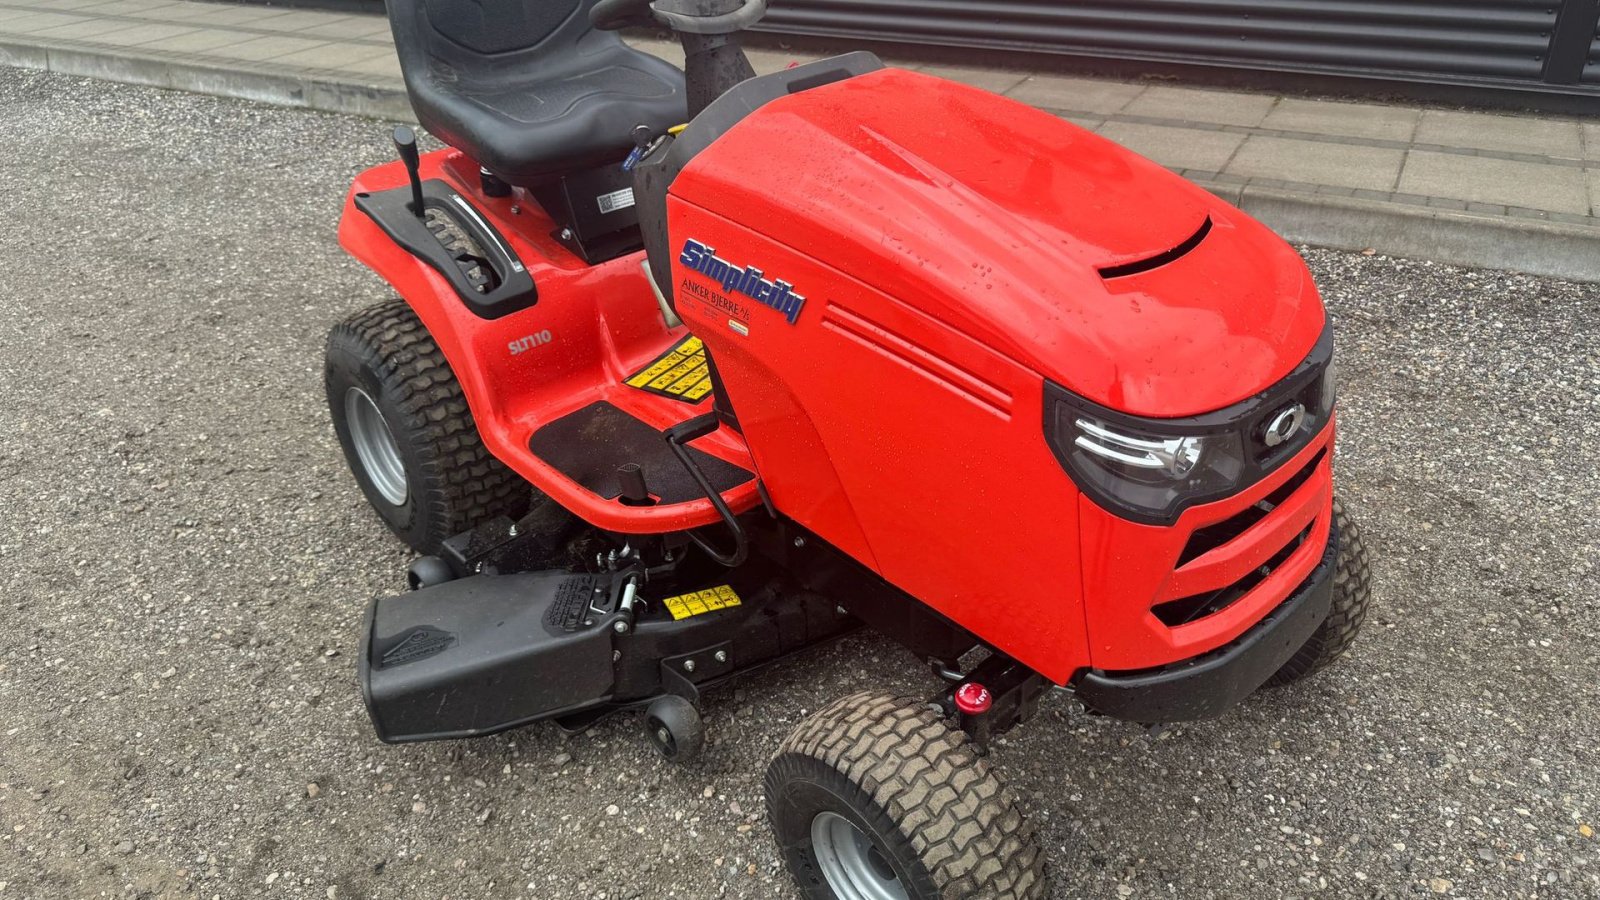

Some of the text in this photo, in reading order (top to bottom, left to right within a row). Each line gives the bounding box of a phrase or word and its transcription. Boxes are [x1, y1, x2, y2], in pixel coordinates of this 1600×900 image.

[680, 238, 806, 325] Simplicity
[681, 278, 709, 303] ANKER
[711, 291, 739, 316] BJERRE
[508, 329, 552, 355] SLT110
